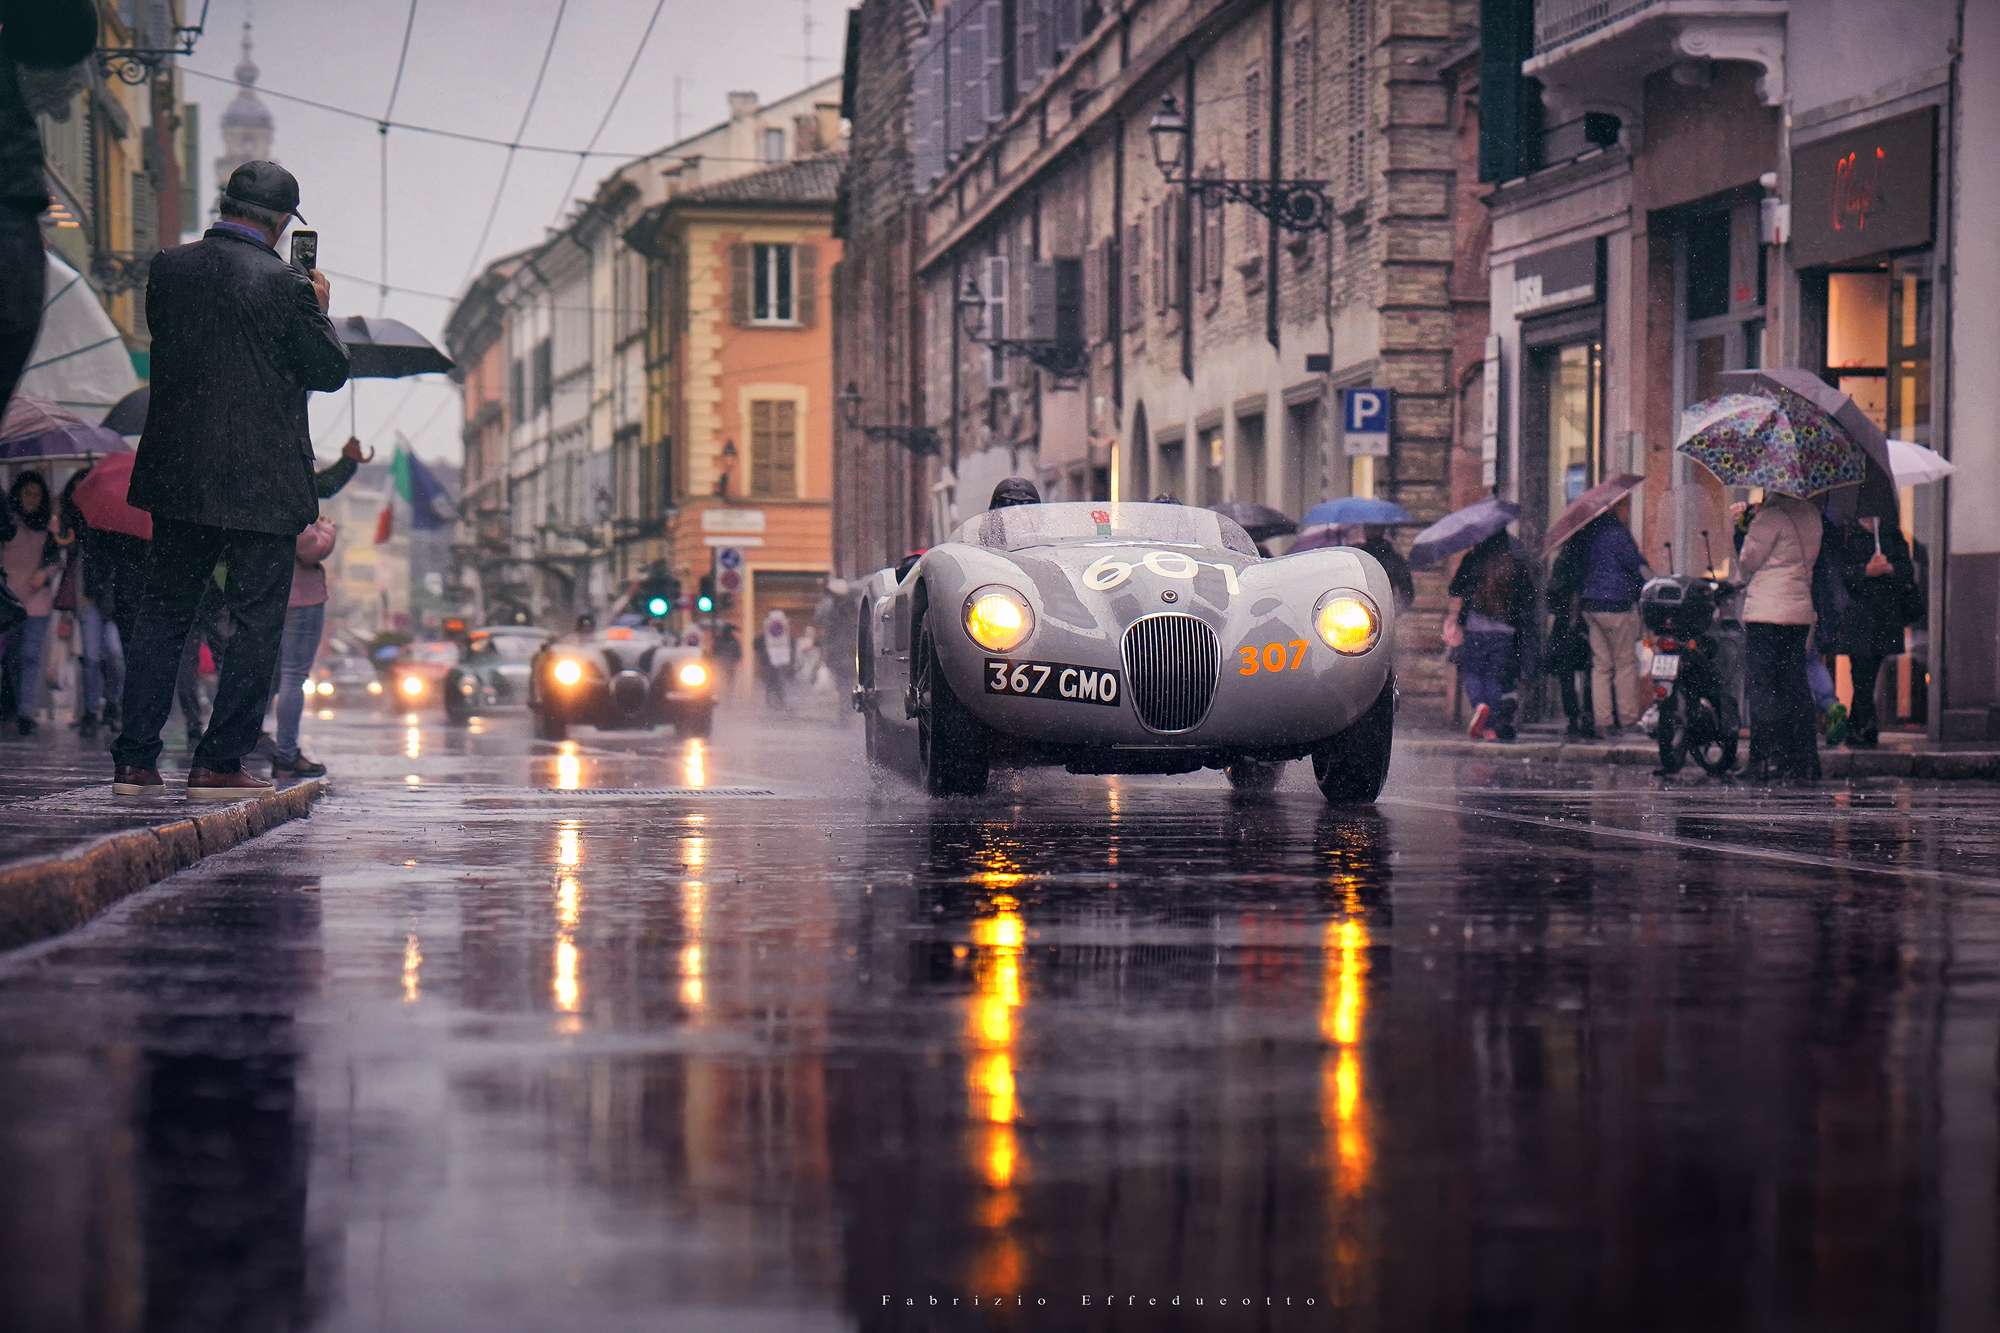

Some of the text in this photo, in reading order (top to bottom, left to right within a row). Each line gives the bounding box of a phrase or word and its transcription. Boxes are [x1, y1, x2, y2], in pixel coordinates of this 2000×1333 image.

[1354, 392, 1381, 429] P
[1082, 551, 1241, 595] 601
[1239, 639, 1311, 676] 307
[989, 662, 1118, 702] 367 GMO
